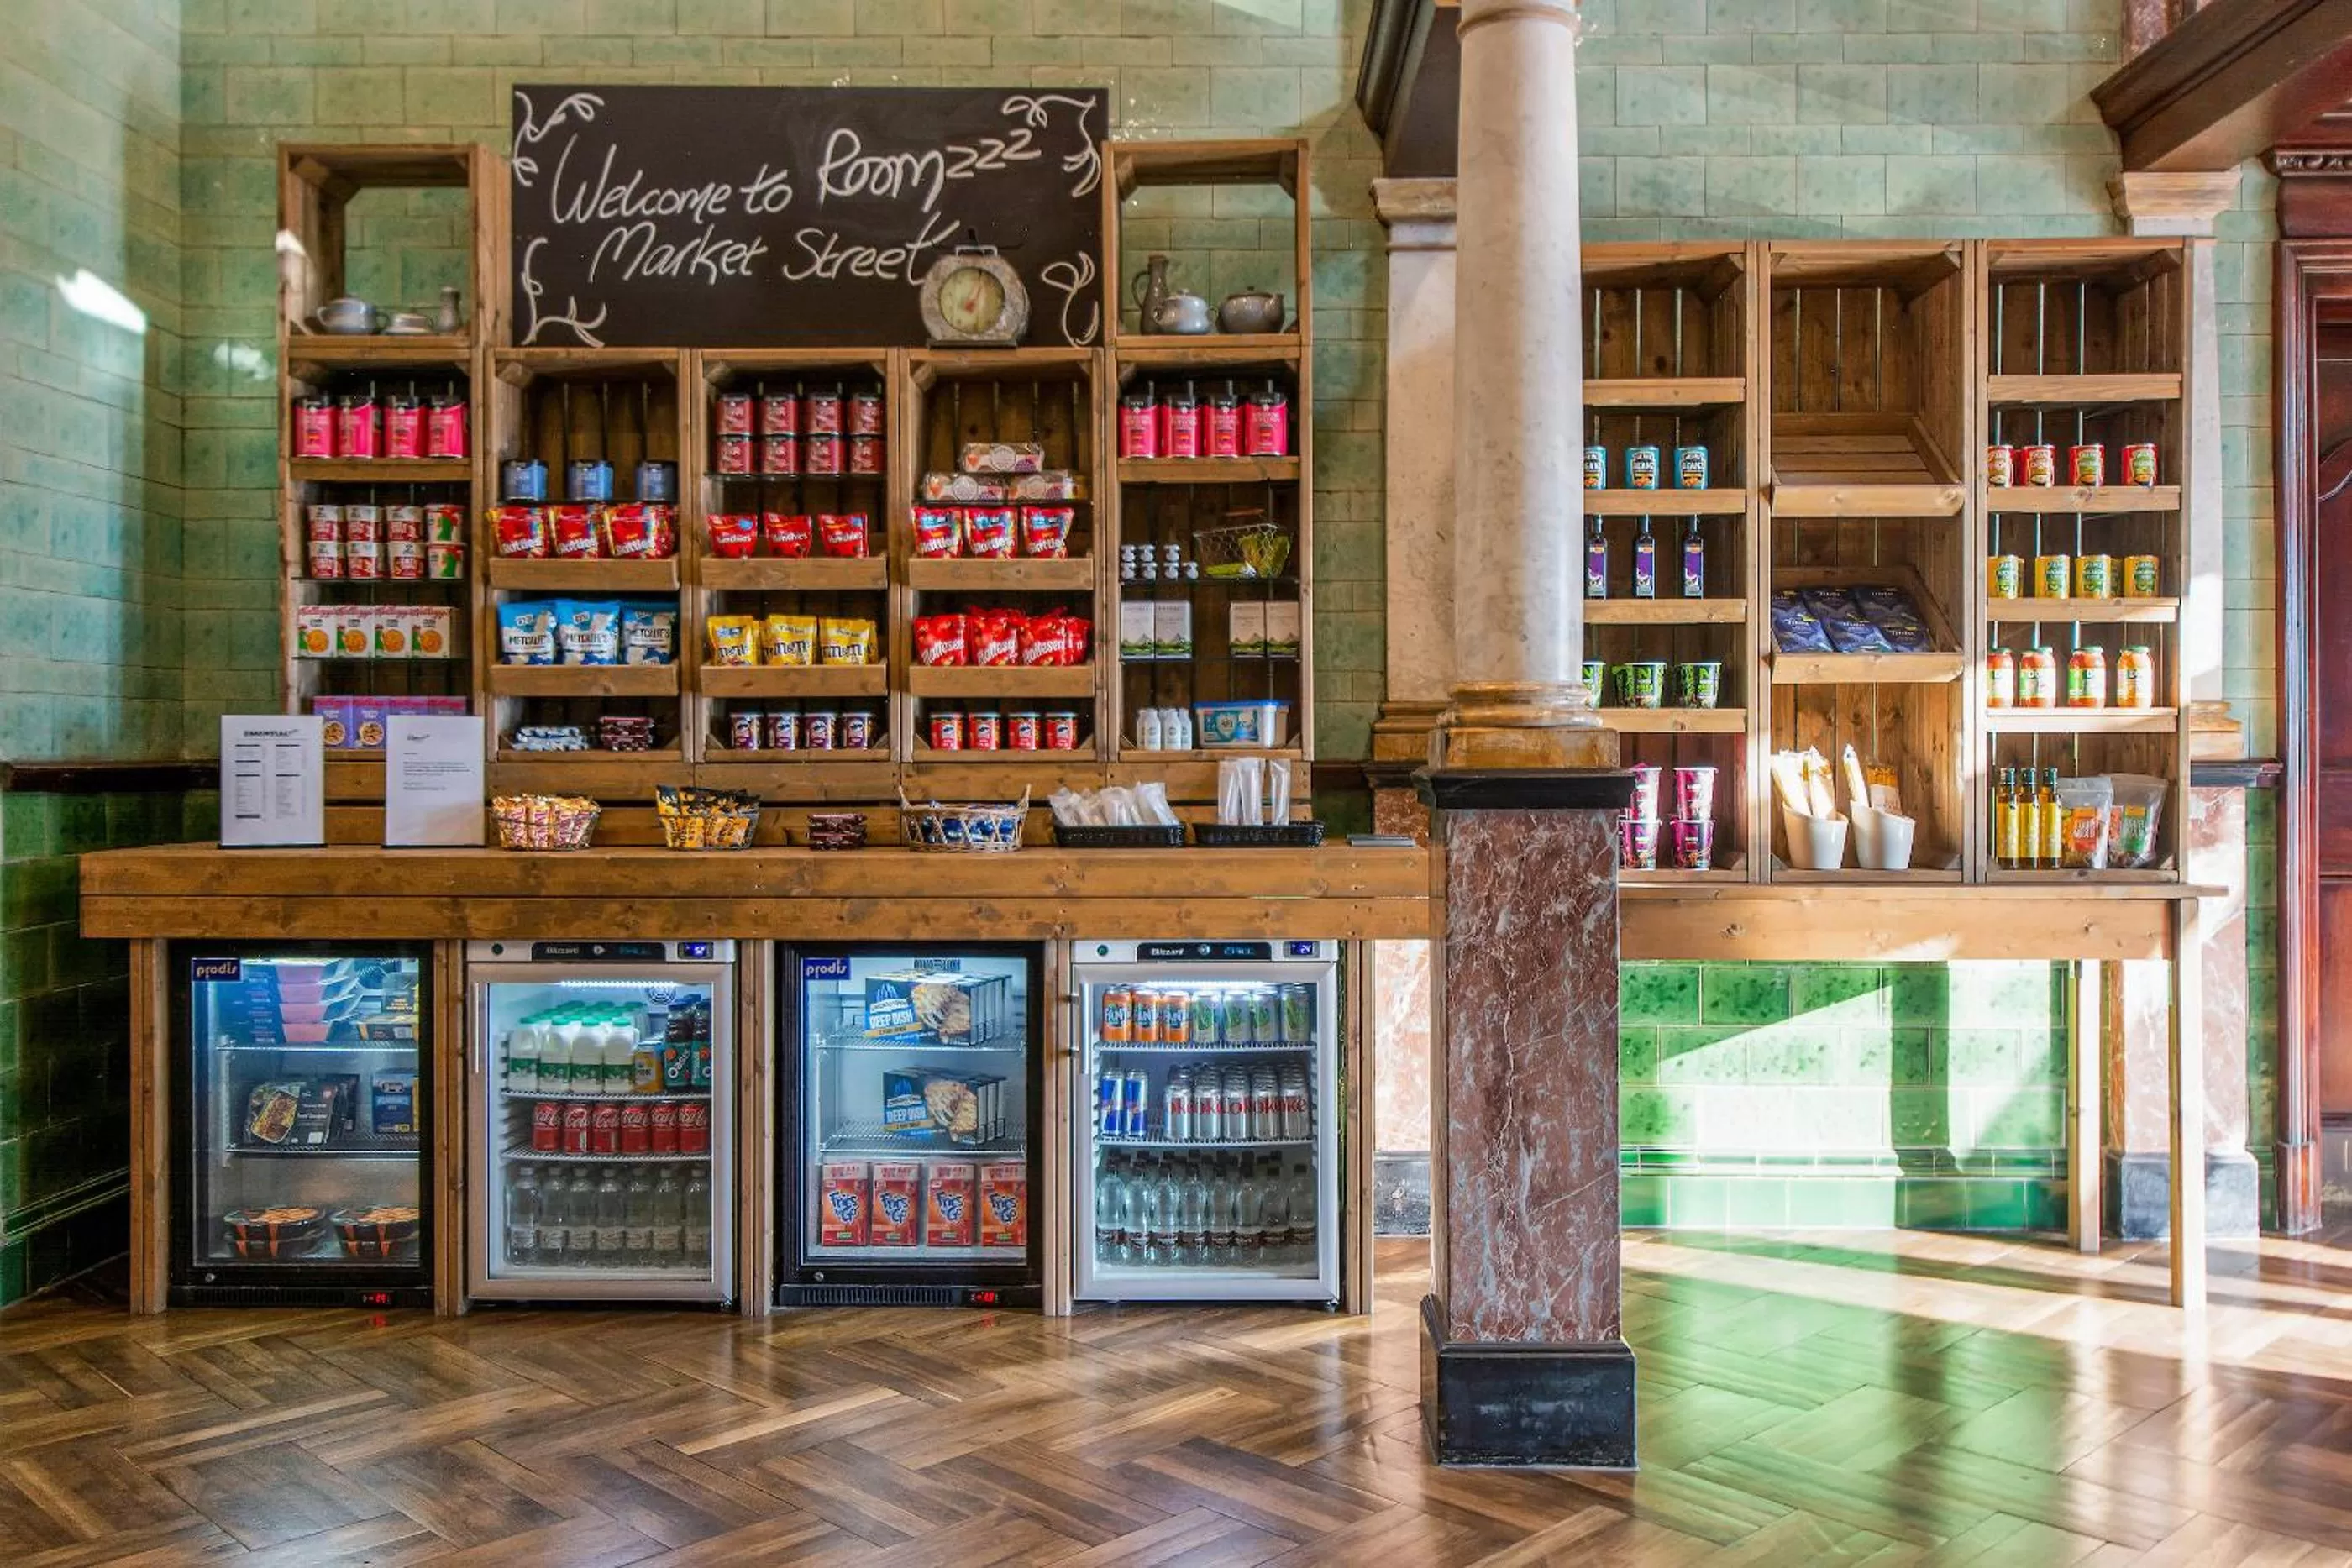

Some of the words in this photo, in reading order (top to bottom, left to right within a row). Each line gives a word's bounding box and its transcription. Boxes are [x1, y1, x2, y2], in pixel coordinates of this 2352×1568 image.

[552, 134, 728, 224] Welcome
[739, 163, 793, 213] to
[590, 221, 768, 285] Market
[782, 210, 960, 286] Street
